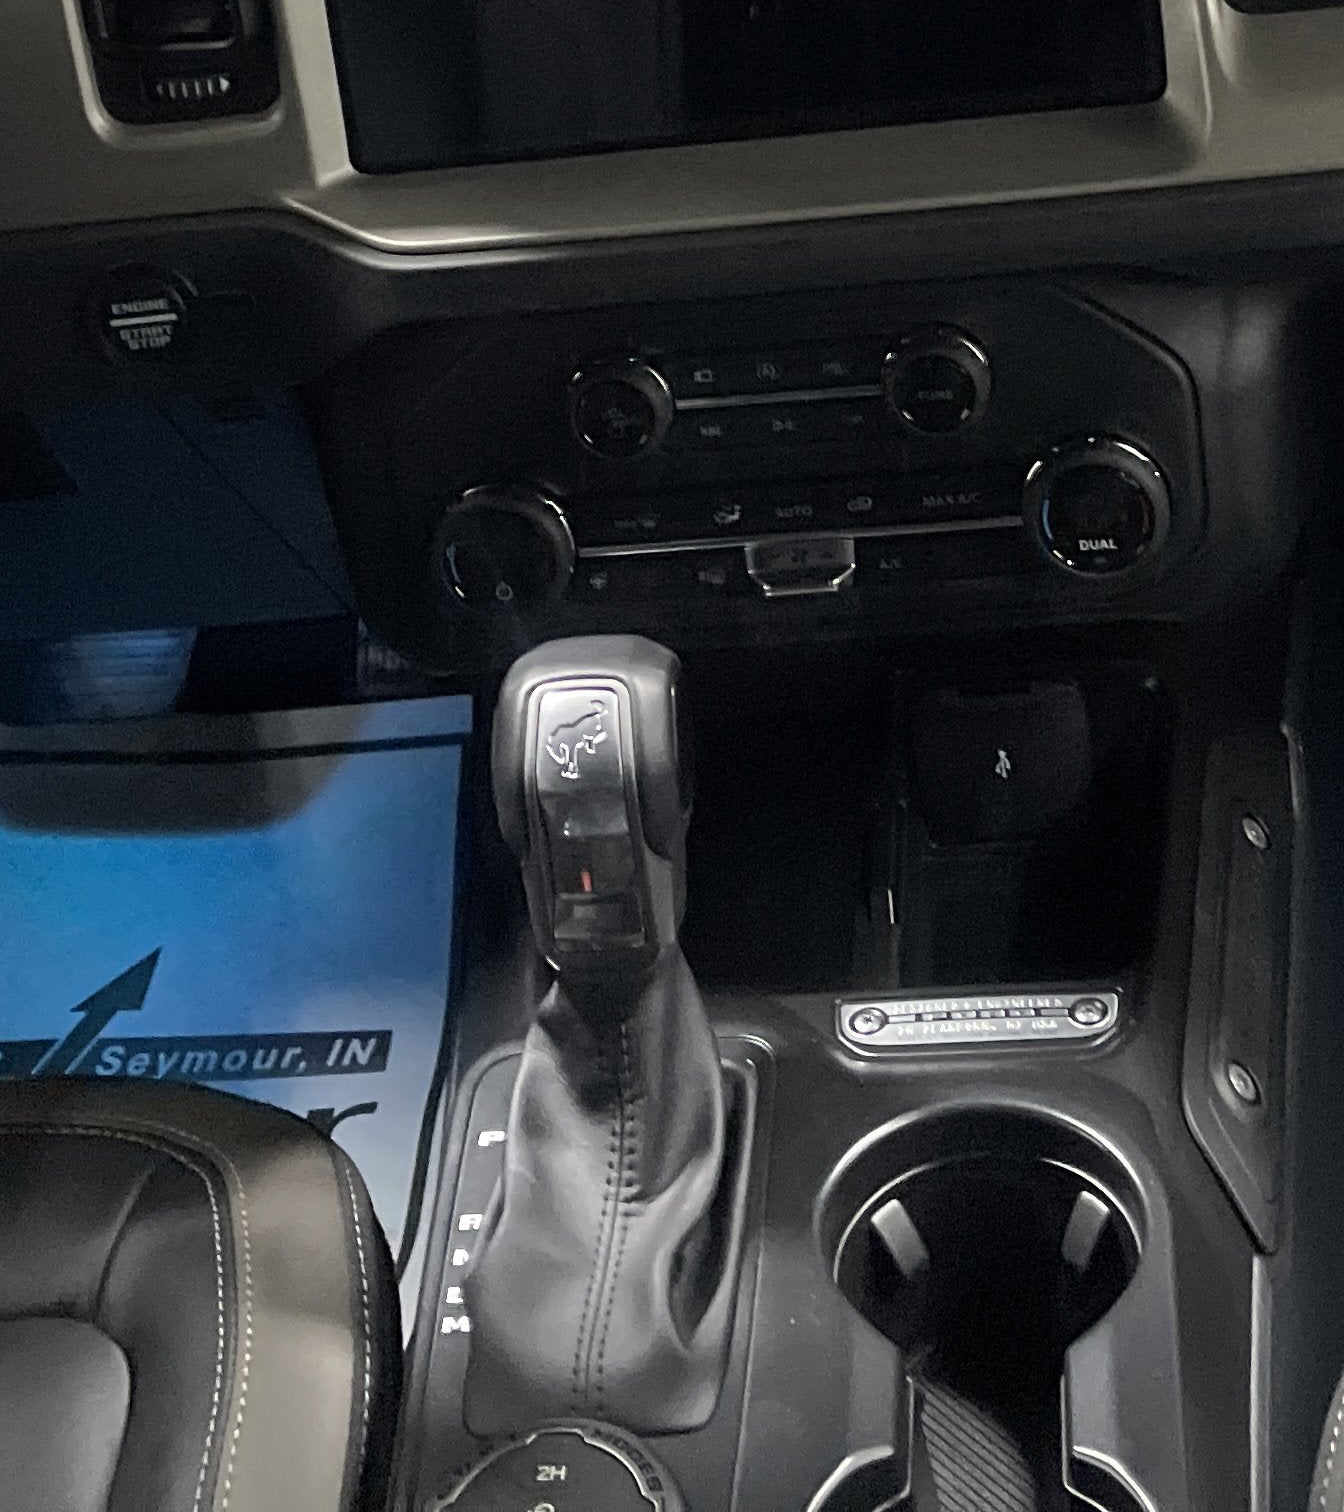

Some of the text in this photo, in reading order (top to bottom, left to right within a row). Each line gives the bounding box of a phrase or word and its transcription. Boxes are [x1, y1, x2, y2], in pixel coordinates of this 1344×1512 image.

[112, 298, 169, 314] ENGINE
[119, 325, 173, 340] START
[129, 336, 171, 350] STOP
[1078, 539, 1118, 551] DUAL
[96, 1038, 376, 1080] Seymour, IN
[477, 1130, 506, 1147] P
[458, 1213, 482, 1231] R
[440, 1315, 472, 1333] M
[536, 1464, 566, 1482] 2H
